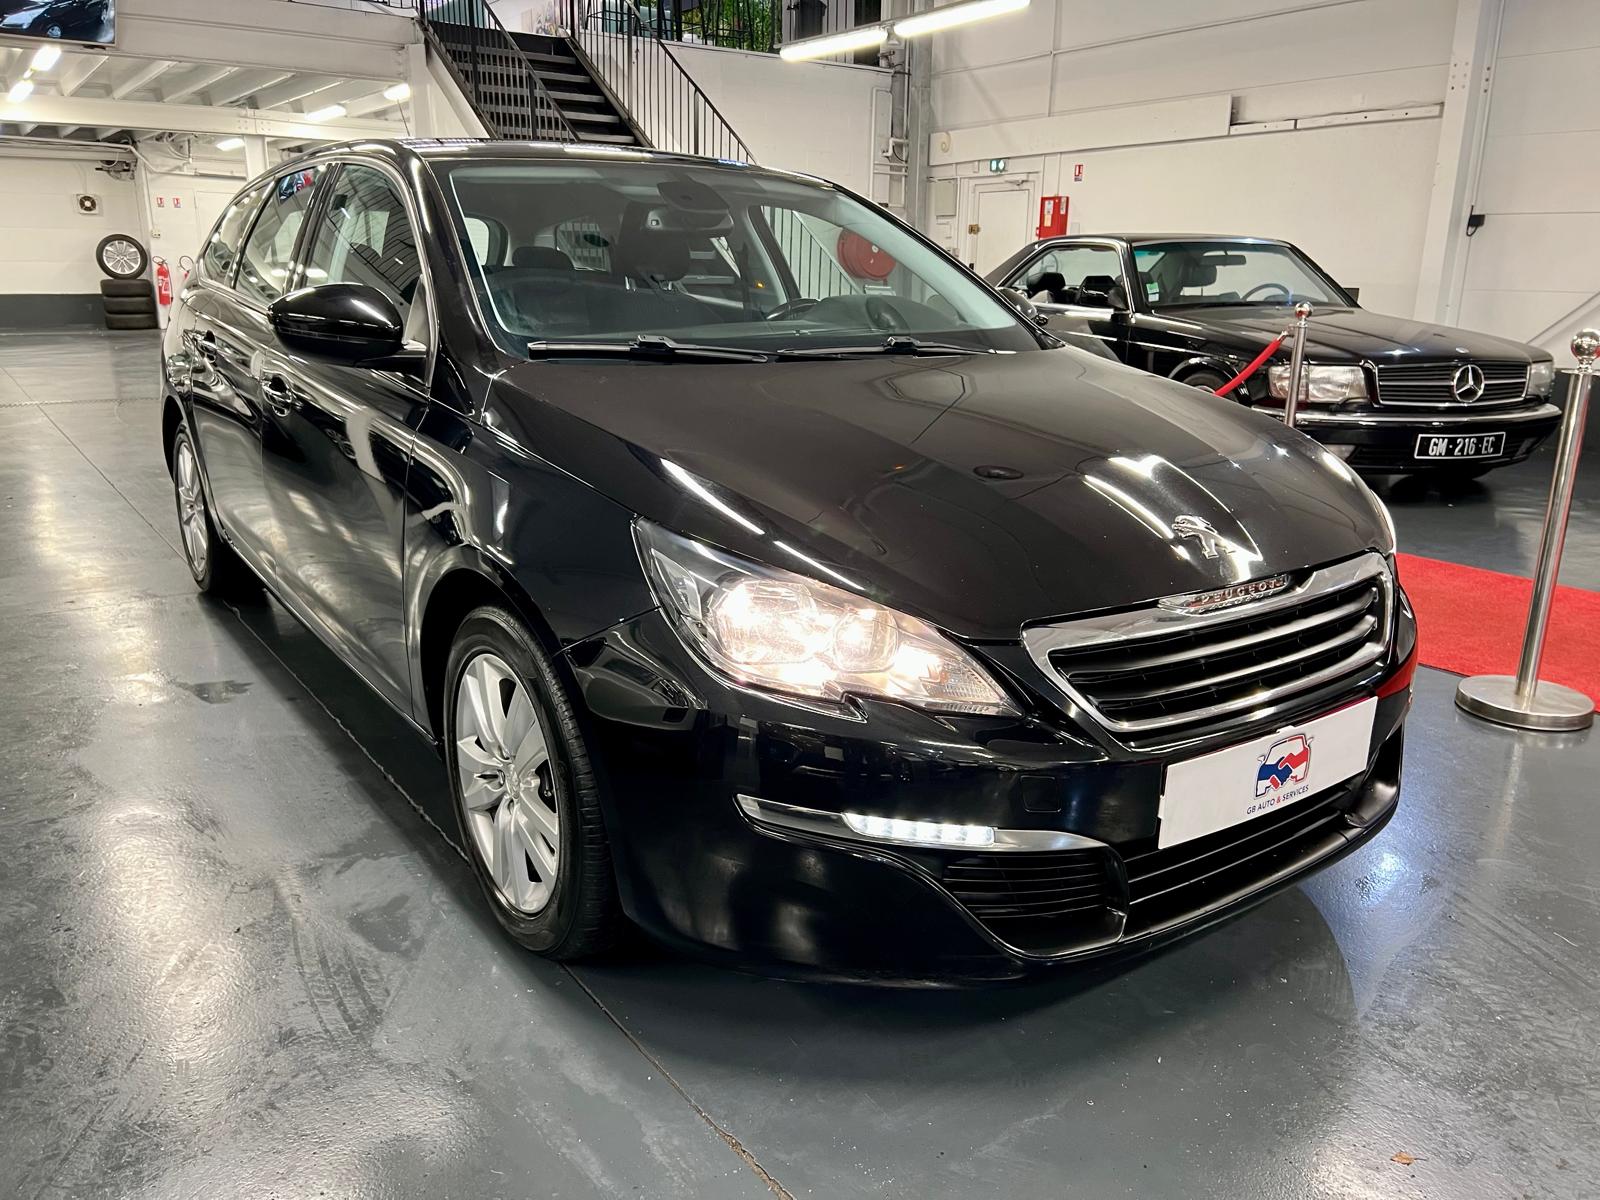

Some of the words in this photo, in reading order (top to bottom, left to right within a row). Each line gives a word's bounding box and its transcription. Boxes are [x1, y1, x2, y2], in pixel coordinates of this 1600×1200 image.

[1201, 578, 1279, 605] PEUGEOT
[1246, 805, 1257, 815] GB
[1257, 798, 1276, 811] AUTO
[1276, 795, 1281, 804] &
[1282, 784, 1309, 802] SERVICES
